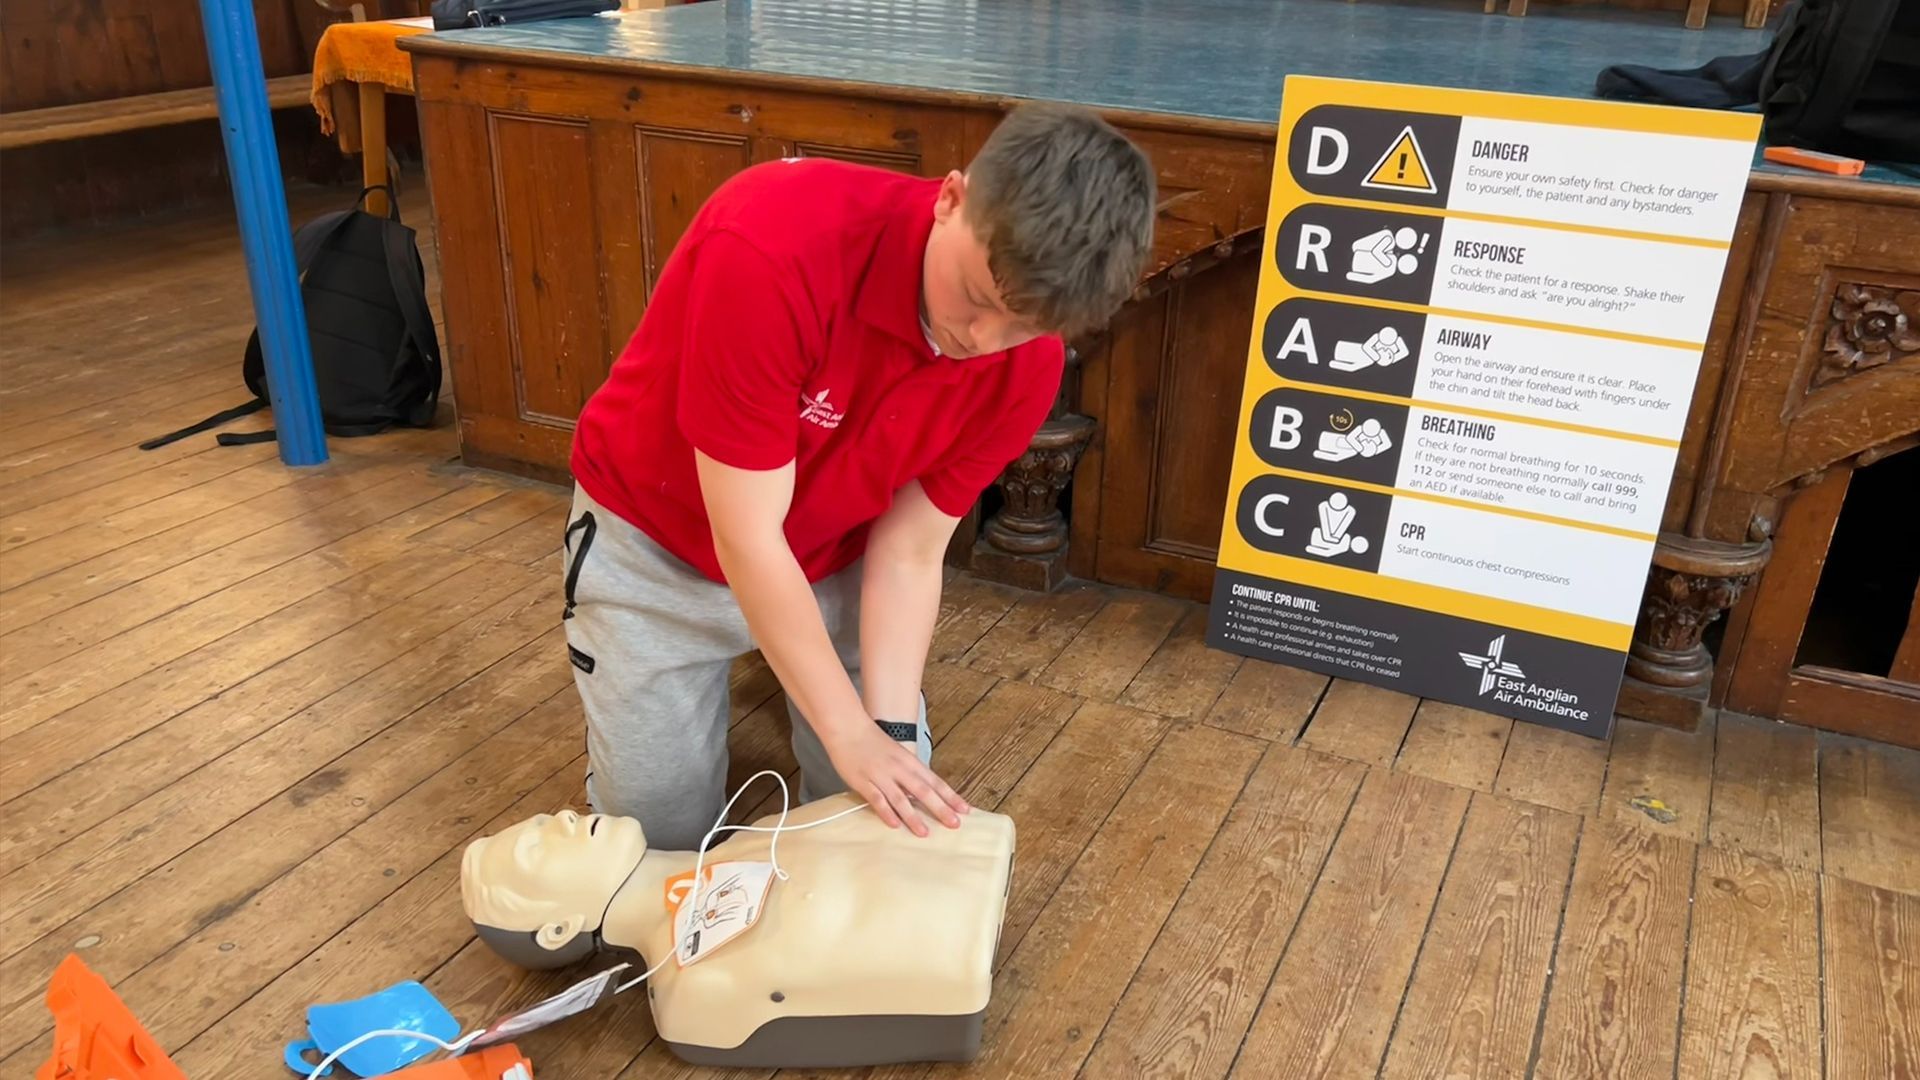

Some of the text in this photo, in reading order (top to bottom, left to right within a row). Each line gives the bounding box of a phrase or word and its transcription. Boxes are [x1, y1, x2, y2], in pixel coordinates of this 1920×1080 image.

[1306, 125, 1349, 175] D
[1471, 139, 1529, 162] DANGER
[1465, 181, 1693, 215] to yourself, the patient and any bystanders.
[1467, 164, 1718, 203] Ensure your own safety first. Check for danger
[1295, 223, 1331, 272] R
[1453, 239, 1526, 264] RESPONSE
[1447, 278, 1495, 294] shoulders
[1497, 286, 1519, 297] and
[1519, 288, 1537, 300] ask
[1565, 296, 1586, 307] you
[1450, 263, 1685, 303] Check the patient for a response. Shake their
[1275, 317, 1318, 364] A
[1436, 328, 1491, 350] AIRWAY
[1430, 367, 1671, 410] your hand on their forehead with fingers under
[1433, 351, 1656, 393] Open the airway and ensure it is clear. Place
[1428, 378, 1581, 411] the chin and tilt the head back.
[1269, 405, 1303, 449] B
[1420, 414, 1495, 441] BREATHING
[1414, 450, 1638, 498] If they are not breathing normally call 999,
[1417, 436, 1645, 484] Check for normal breathing for 10 seconds.
[1408, 479, 1504, 503] an AED if available.
[1413, 464, 1636, 514] 112 or send someone else to call and bring
[1253, 493, 1289, 536] C
[1399, 522, 1425, 541] CPR
[1396, 543, 1570, 585] Start continuous chest compressions
[1231, 583, 1320, 612] CONTINUE CPR UNTIL:
[1233, 610, 1239, 618] It
[1246, 614, 1280, 627] impossible
[1280, 621, 1288, 629] to
[1288, 623, 1318, 635] continue
[1236, 599, 1248, 608] The
[1248, 603, 1272, 614] patient
[1272, 609, 1302, 620] responds
[1311, 616, 1334, 628] begins
[1334, 621, 1368, 636] breathing
[1368, 629, 1399, 643] normally
[1230, 632, 1400, 678] A health care professional directs that CPR be ceased
[1231, 621, 1402, 666] A health care professional arrives and takes over CPR
[1493, 689, 1588, 720] Air Ambulance
[1497, 676, 1578, 704] East Anglian
